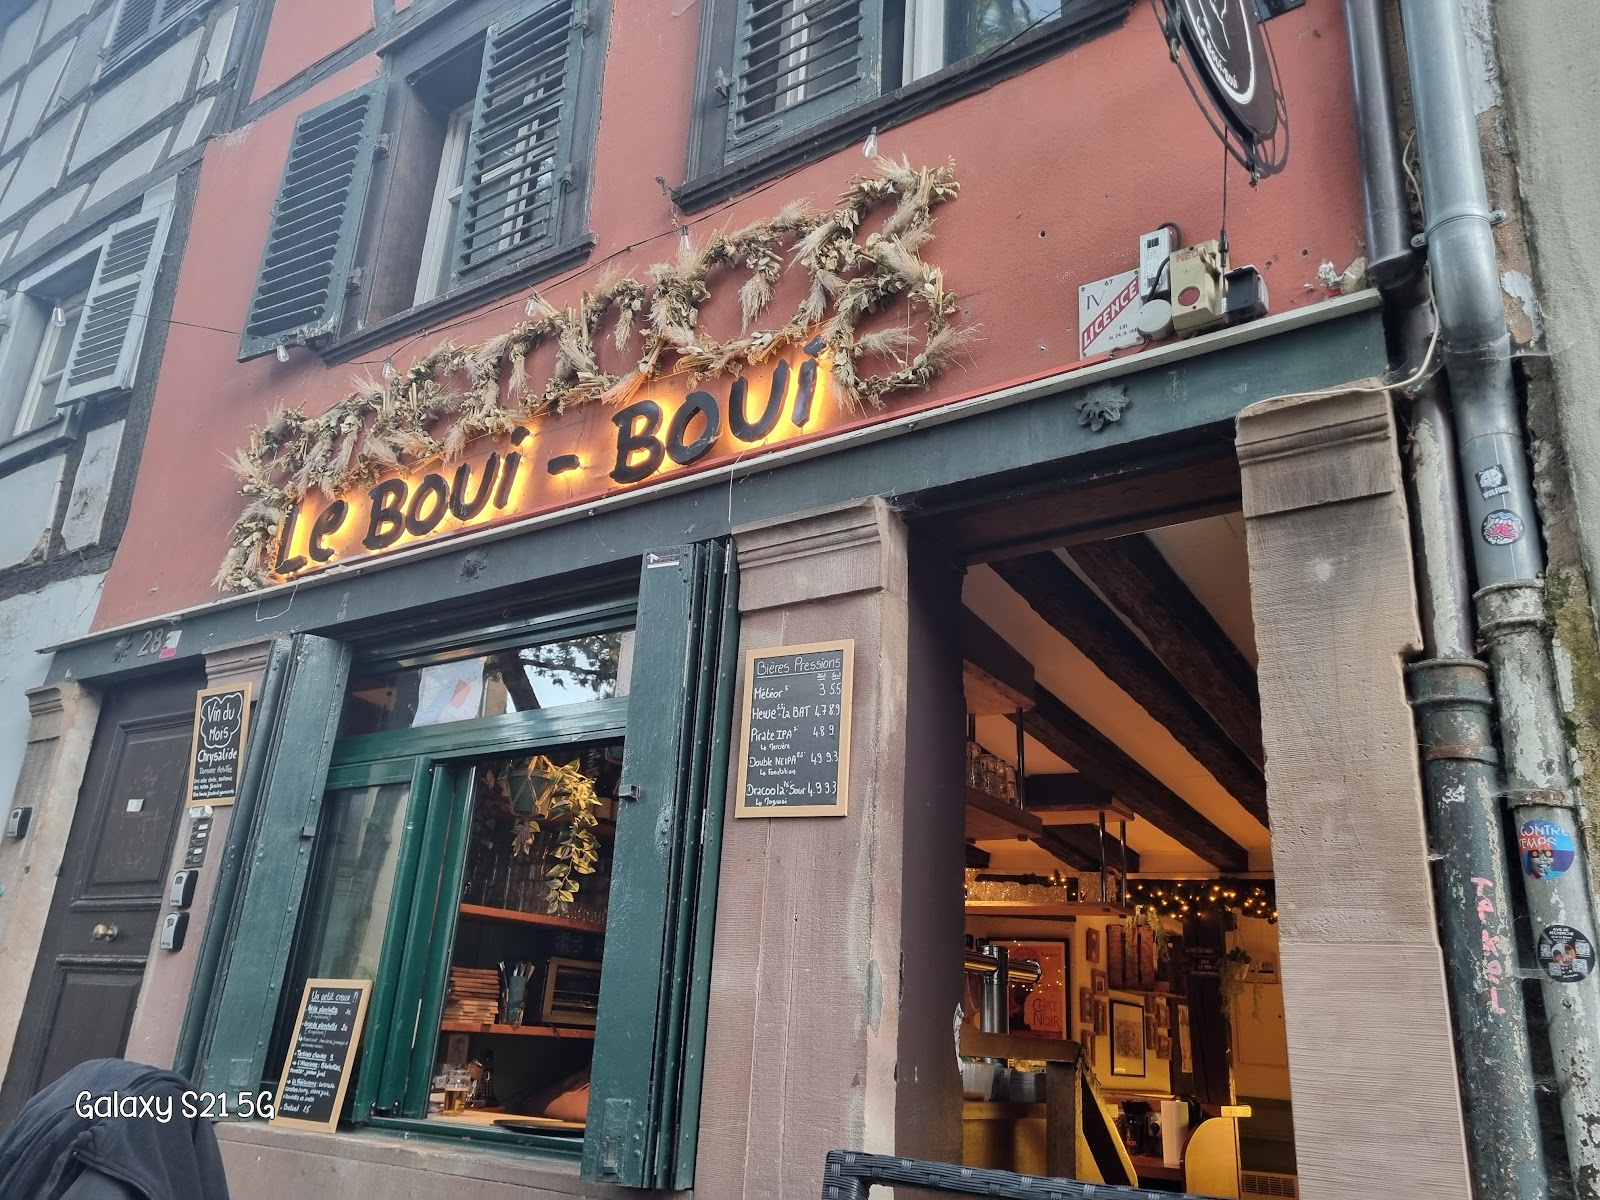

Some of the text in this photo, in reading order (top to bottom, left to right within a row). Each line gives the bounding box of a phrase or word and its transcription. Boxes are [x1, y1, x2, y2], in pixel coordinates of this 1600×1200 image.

[1104, 278, 1113, 287] 67
[1086, 290, 1106, 311] IV
[1082, 279, 1140, 348] LICENCE
[275, 499, 348, 574] Le
[137, 627, 164, 657] 28
[757, 656, 841, 676] Bières Pressions
[754, 686, 783, 700] Météor
[819, 683, 826, 696] 3
[829, 682, 841, 695] 5.5
[207, 700, 235, 723] Vin du
[792, 704, 811, 718] BAT
[814, 704, 826, 718] 4.7
[829, 703, 840, 716] 8.9
[209, 725, 229, 741] Mois
[751, 727, 775, 742] Pirate
[776, 729, 792, 740] IPA
[813, 725, 825, 737] 4.8
[197, 747, 238, 767] Chrysalide
[749, 756, 773, 768] Double
[775, 754, 797, 766] NEIPA
[826, 750, 839, 763] 9.3
[746, 783, 785, 797] Dracoola
[320, 991, 334, 1003] petit
[1033, 998, 1057, 1012] CHAT
[1033, 1012, 1060, 1031] NOIR
